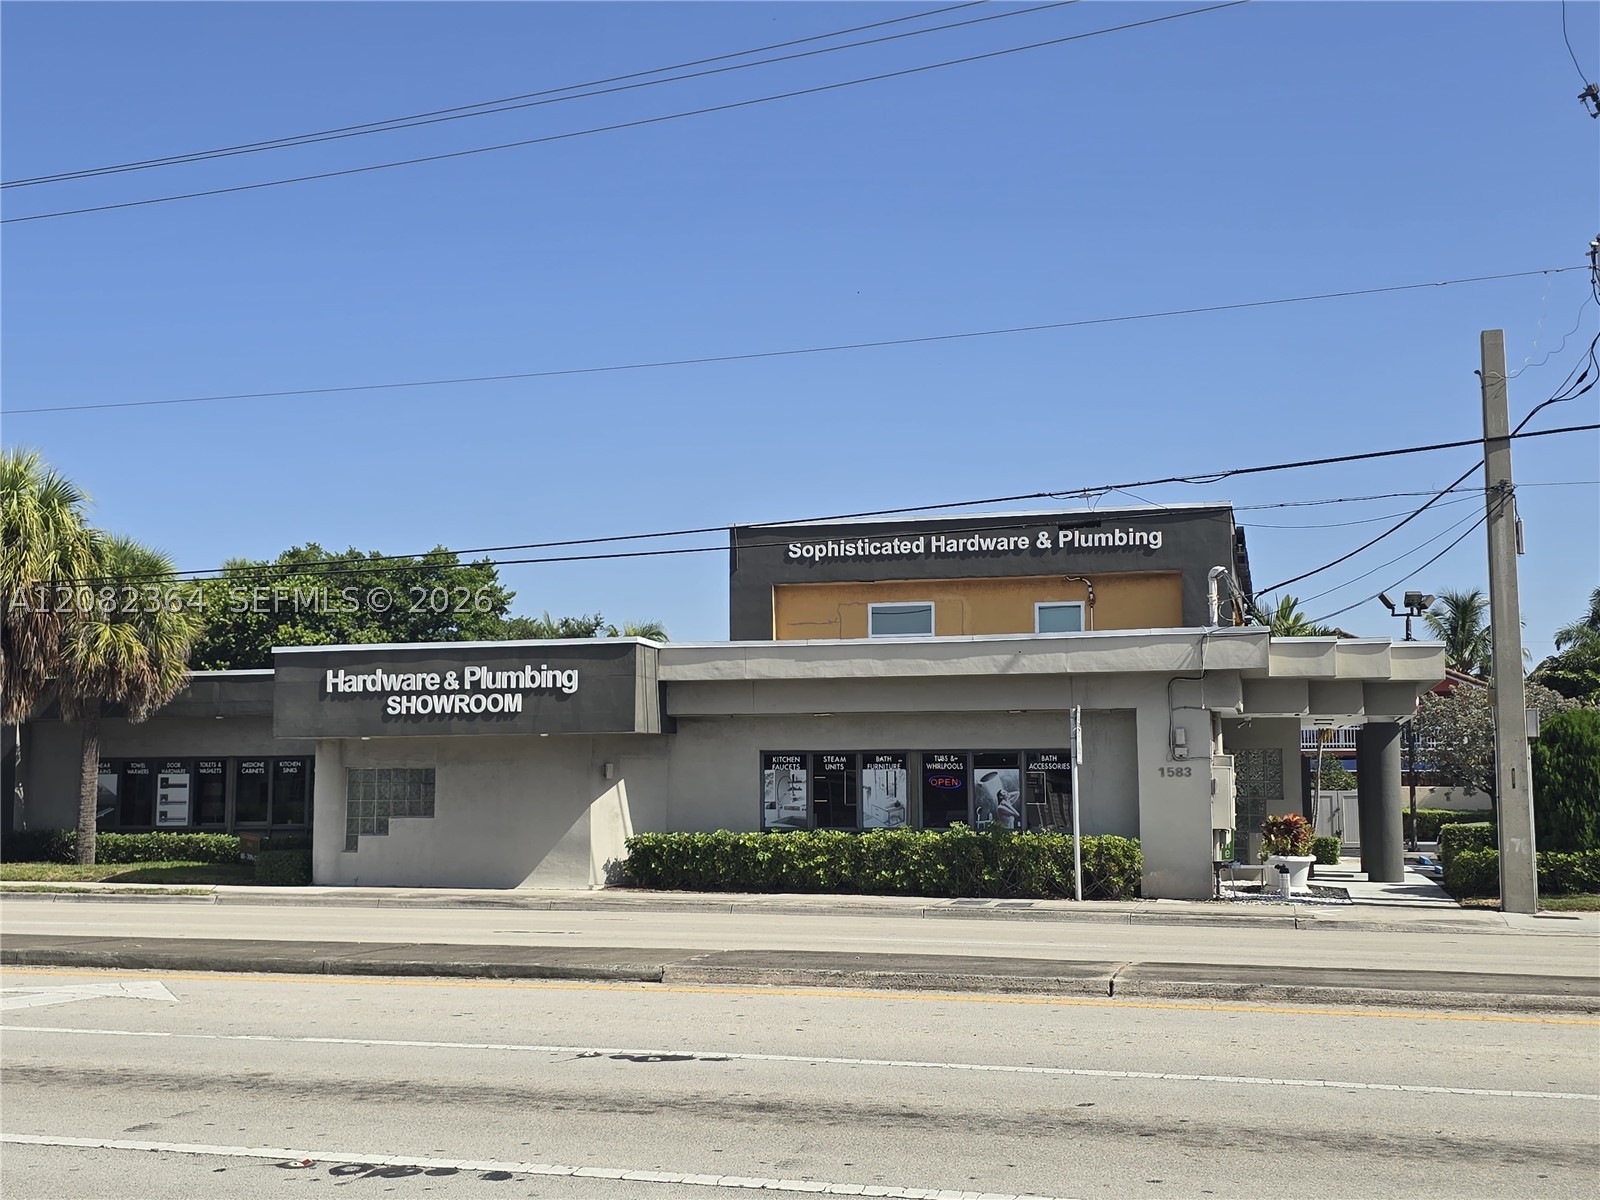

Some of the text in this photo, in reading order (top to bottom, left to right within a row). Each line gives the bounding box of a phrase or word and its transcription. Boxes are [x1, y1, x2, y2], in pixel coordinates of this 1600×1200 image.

[788, 528, 1163, 561] Sophisticated Hardware & Plumbing
[326, 664, 579, 694] Hardware & Plumbing
[386, 693, 522, 715] SHOWROOM
[823, 755, 847, 763] STEAM
[1158, 767, 1192, 778] 1583
[930, 777, 959, 786] OPEN
